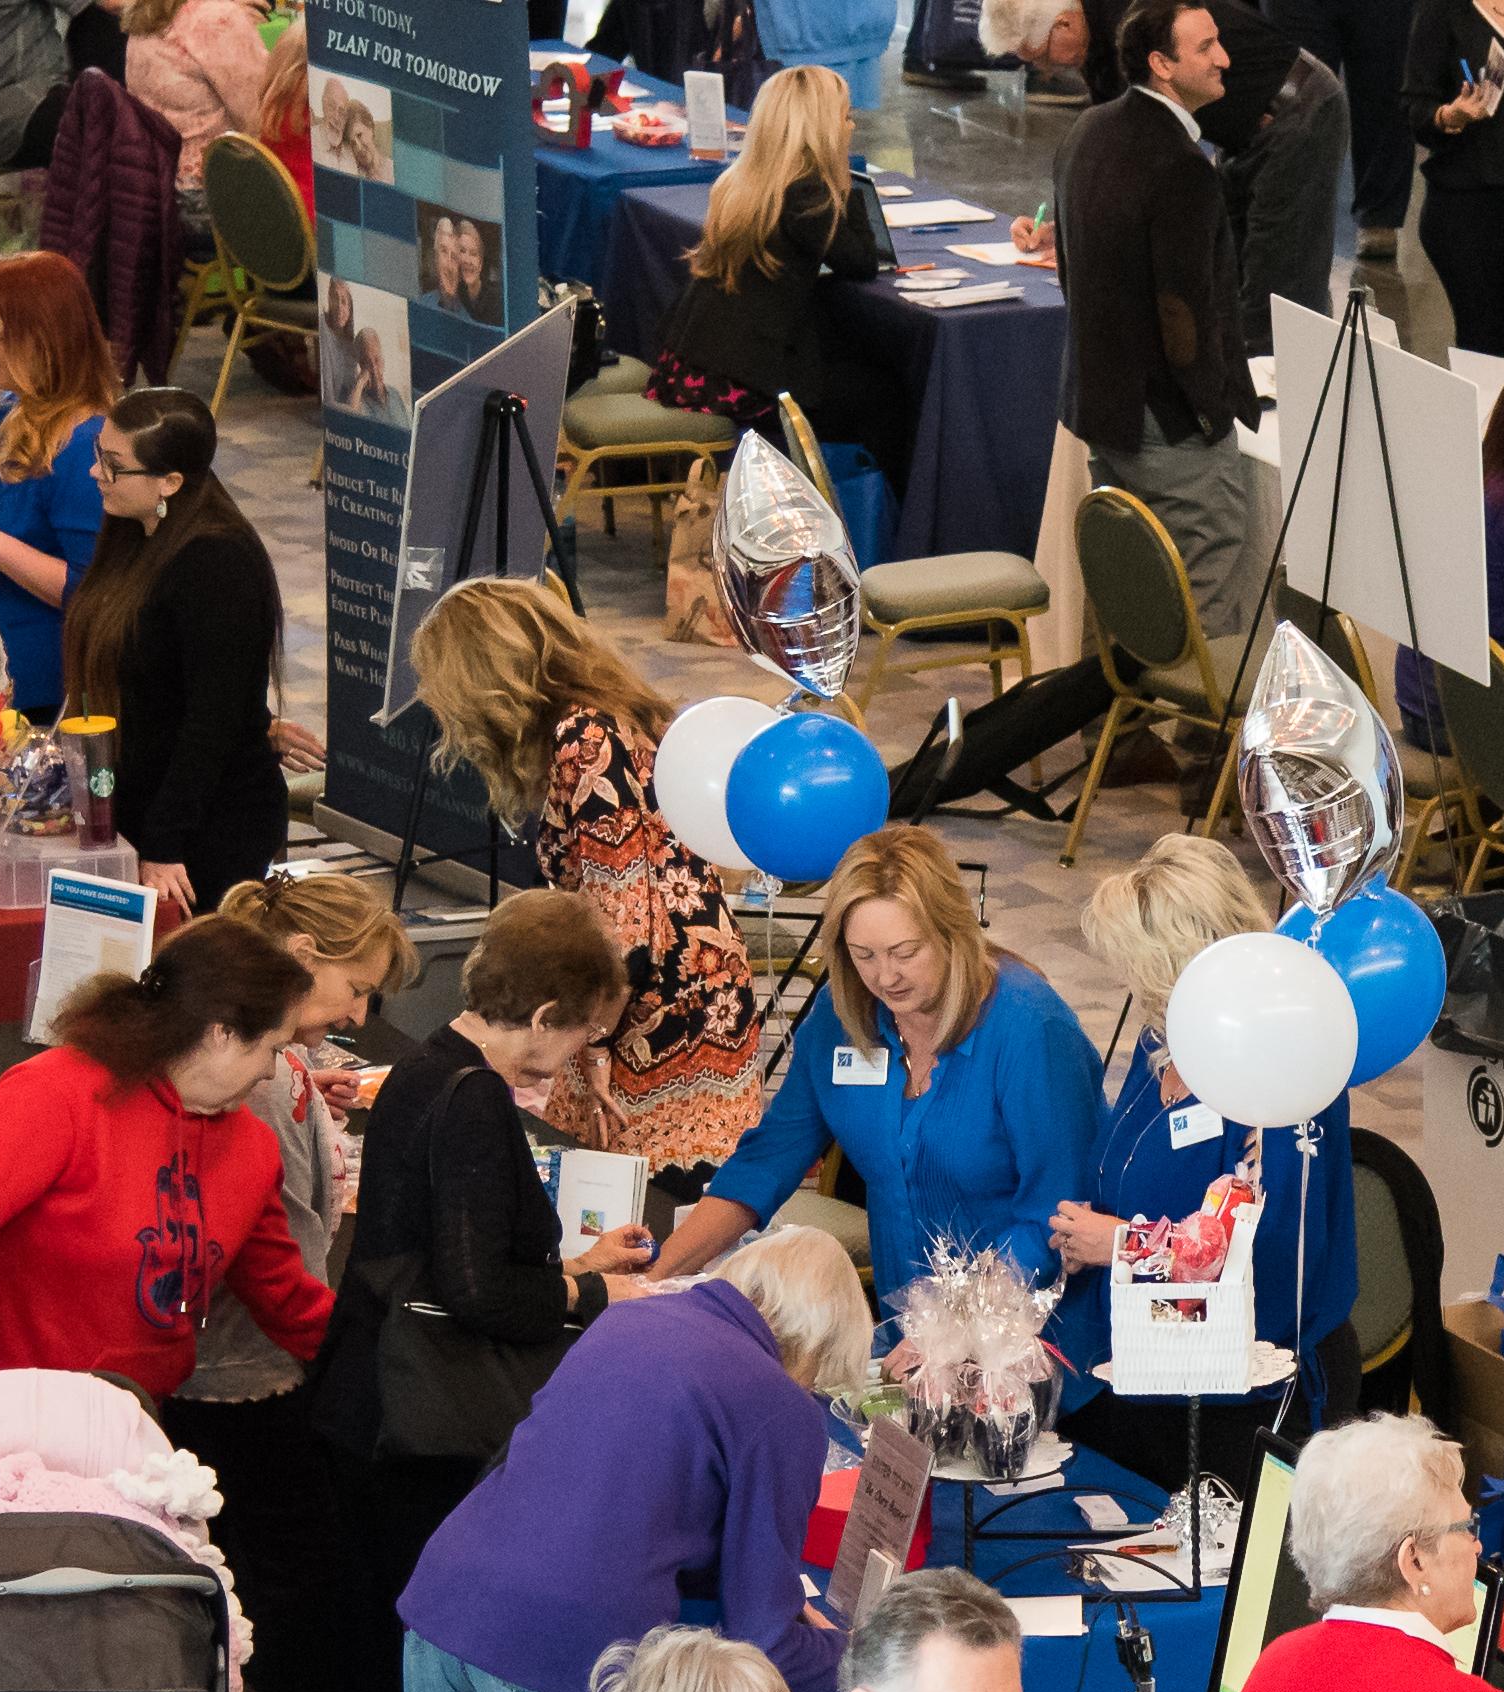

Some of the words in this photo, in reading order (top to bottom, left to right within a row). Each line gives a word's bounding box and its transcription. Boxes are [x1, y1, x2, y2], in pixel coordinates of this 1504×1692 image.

[369, 4, 416, 39] TODAY,
[326, 29, 369, 58] PLAN
[373, 41, 401, 69] FOR
[405, 53, 502, 97] TOMORROW
[355, 437, 400, 465] PROBATE
[367, 479, 389, 500] THE
[331, 567, 374, 597] PROTECT
[331, 593, 368, 620] ESTATE
[334, 631, 357, 654] PASS
